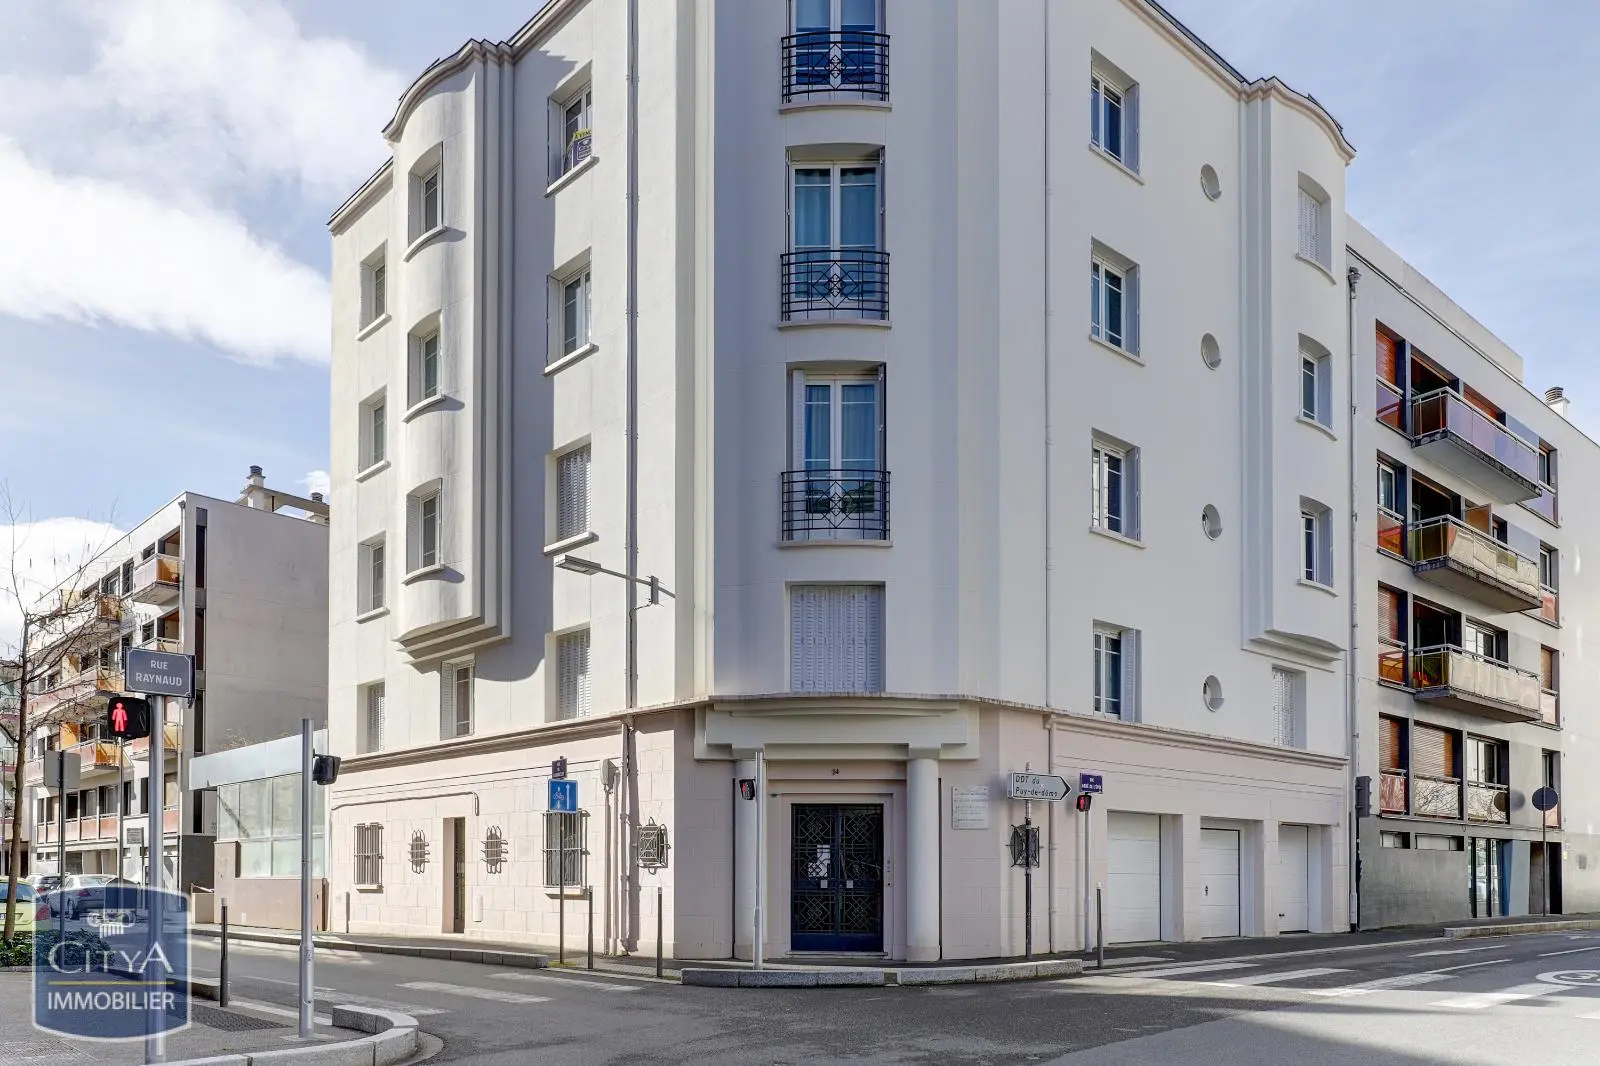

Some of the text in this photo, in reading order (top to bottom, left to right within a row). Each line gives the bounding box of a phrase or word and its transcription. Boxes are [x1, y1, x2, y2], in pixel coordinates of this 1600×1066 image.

[150, 660, 168, 670] RUE
[135, 672, 182, 687] RAYNAUD
[1015, 775, 1029, 783] DDT
